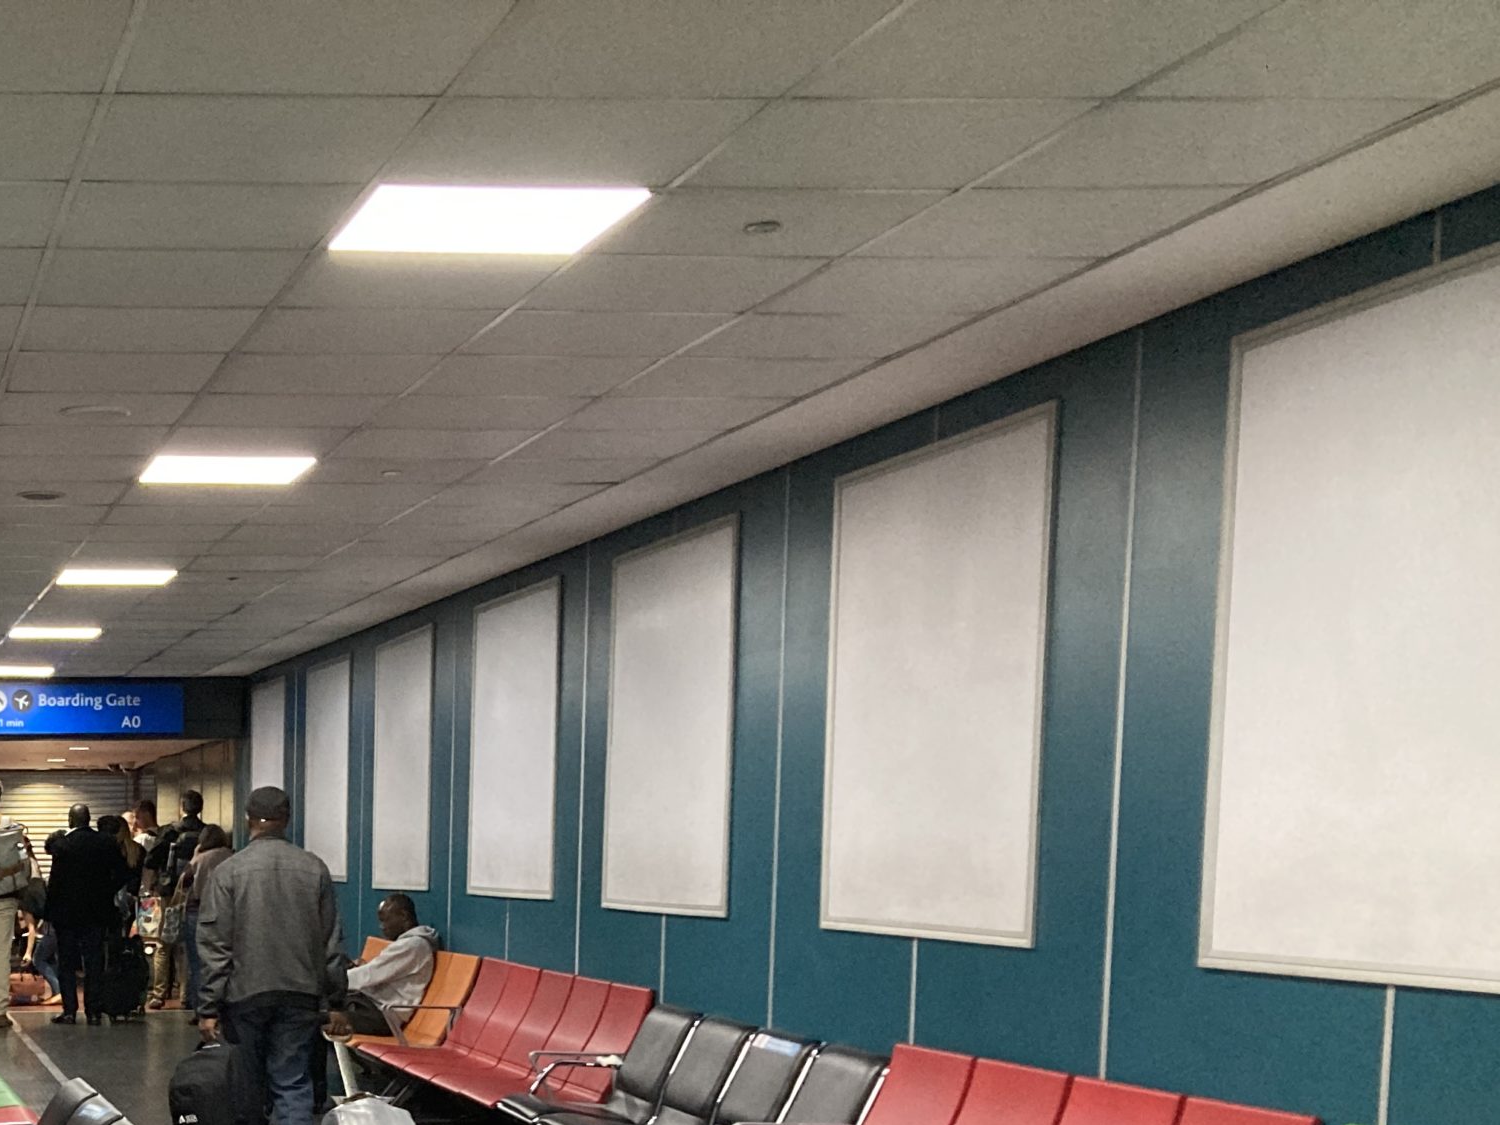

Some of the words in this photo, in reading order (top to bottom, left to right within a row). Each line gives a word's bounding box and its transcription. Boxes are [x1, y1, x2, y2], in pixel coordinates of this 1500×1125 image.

[38, 693, 103, 710] Boarding
[105, 693, 141, 706] Gate
[5, 718, 25, 727] min
[121, 715, 141, 729] A0
